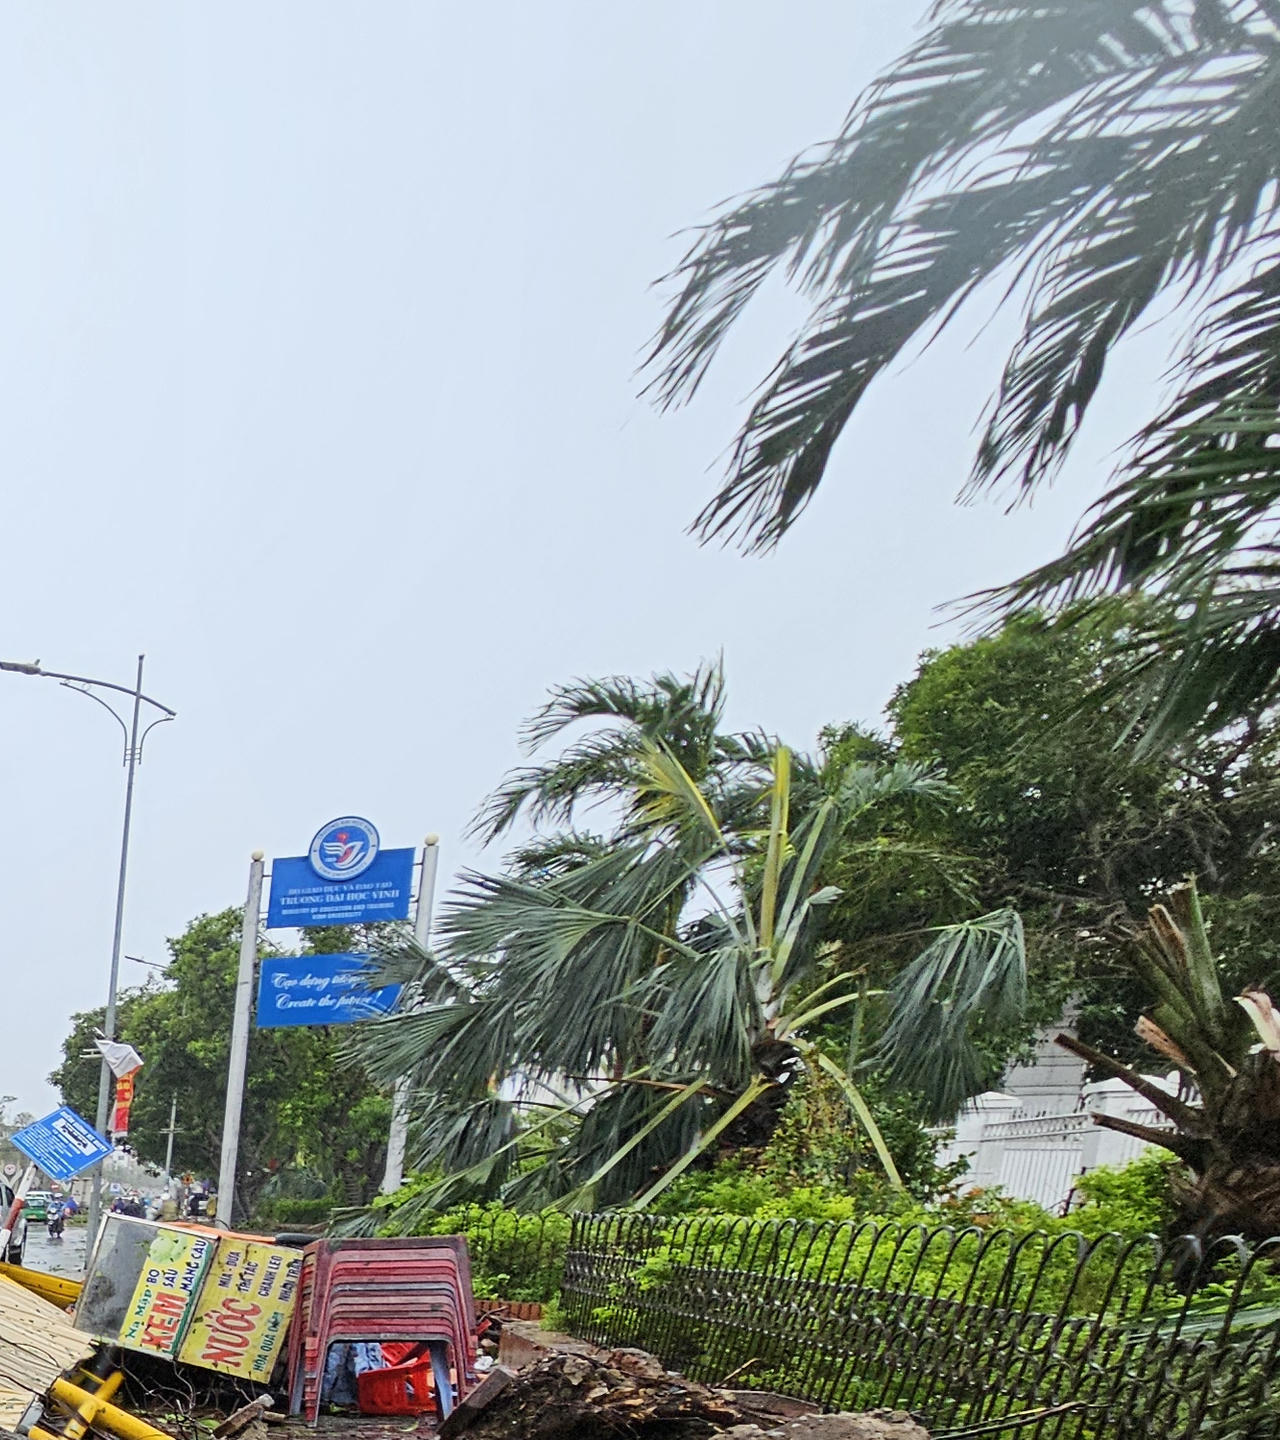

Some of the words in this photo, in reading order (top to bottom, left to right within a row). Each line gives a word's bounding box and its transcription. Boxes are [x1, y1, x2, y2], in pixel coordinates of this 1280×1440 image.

[275, 992, 318, 1009] Create
[318, 993, 337, 1007] the
[141, 1291, 187, 1349] KEM
[201, 1297, 262, 1367] NƯỚC
